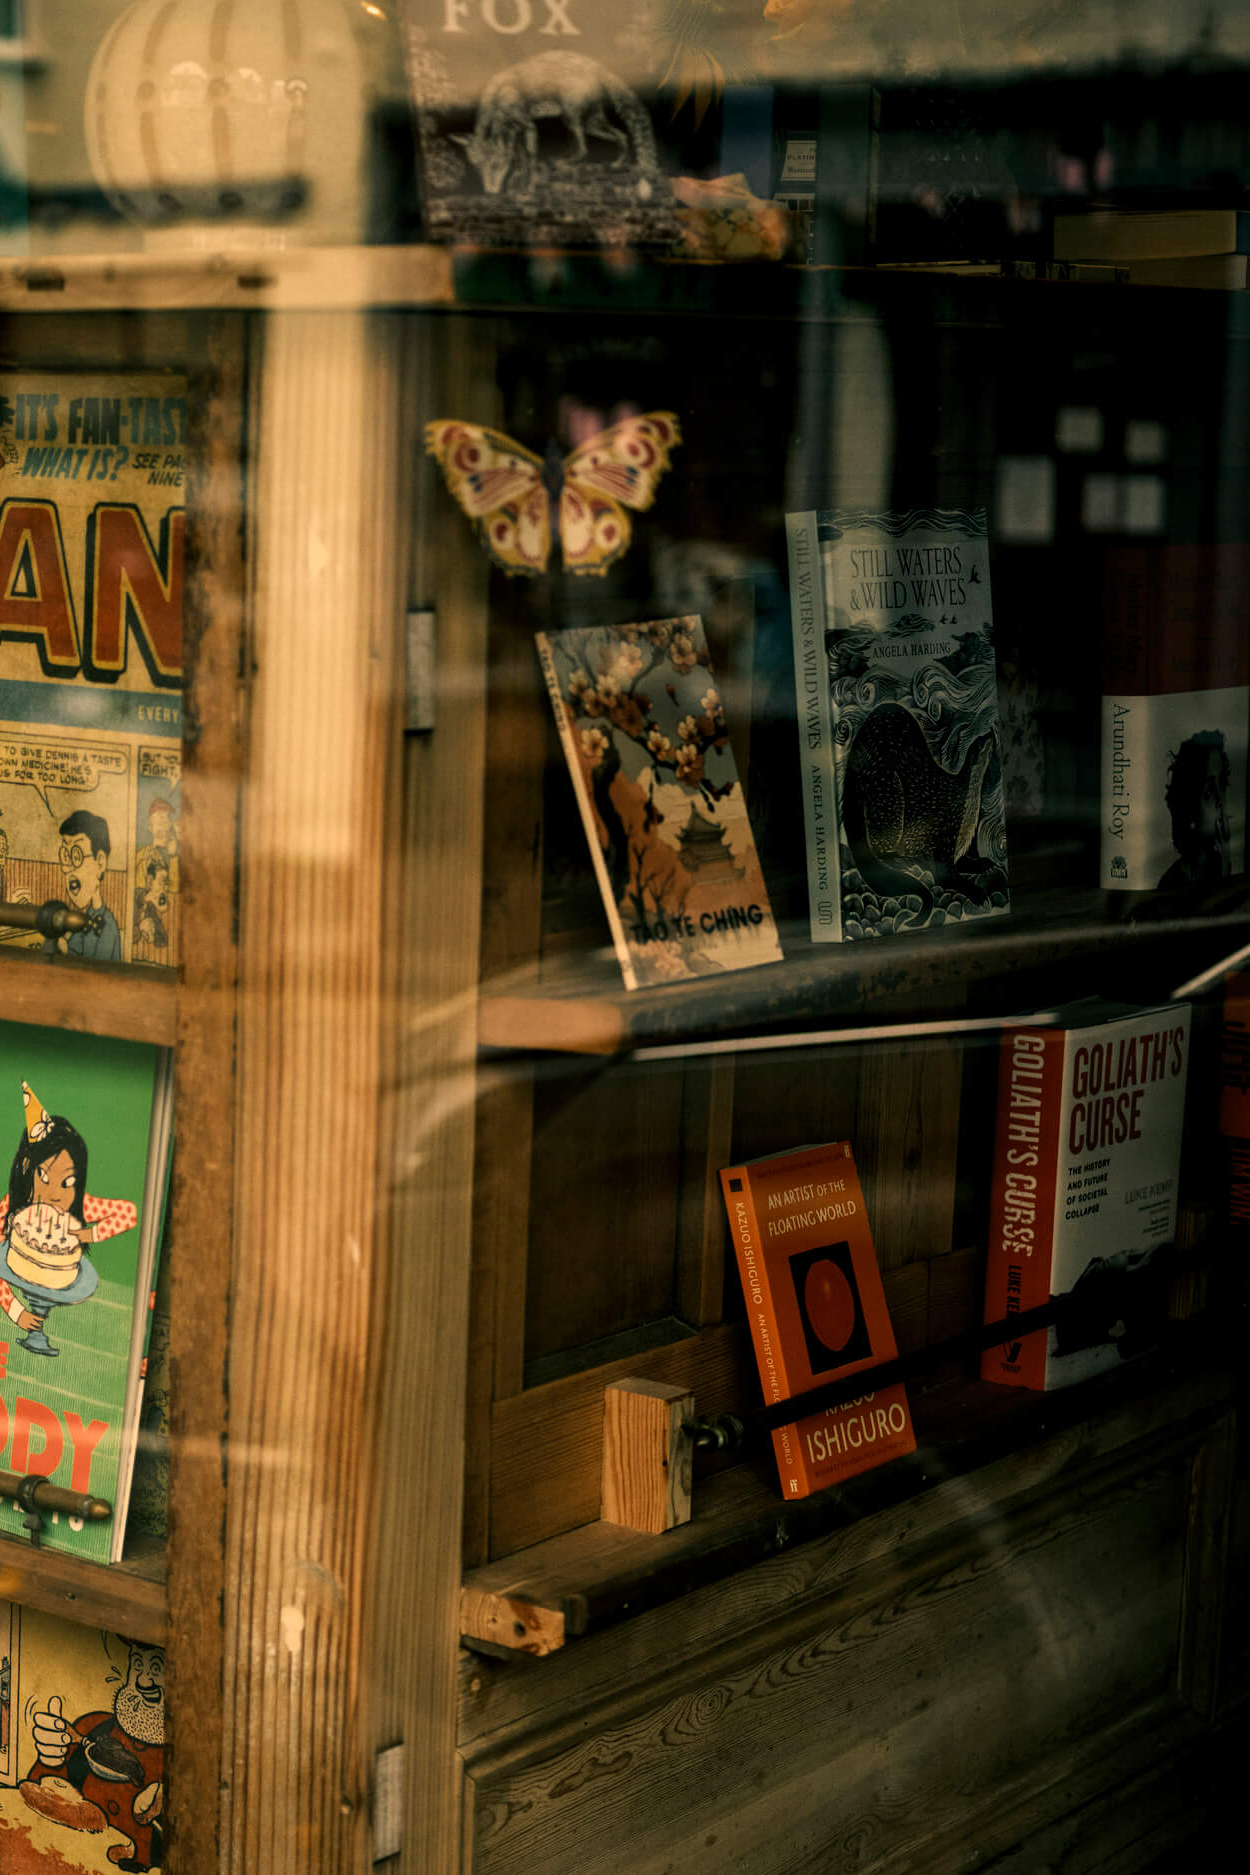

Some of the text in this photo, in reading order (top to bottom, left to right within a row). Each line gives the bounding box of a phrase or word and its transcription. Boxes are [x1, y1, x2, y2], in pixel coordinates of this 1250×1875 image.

[441, 0, 582, 36] FOX
[13, 393, 58, 442] IT'S
[21, 444, 129, 482] WHAT IS?
[132, 453, 157, 470] SEE
[147, 471, 183, 488] NINE
[850, 546, 962, 578] STILL WATERS
[861, 580, 908, 609] WILD
[910, 578, 967, 607] WAVES
[872, 641, 951, 659] ANGELA HARDING
[138, 704, 180, 724] EVERY
[796, 527, 829, 891] STILL WATERS & WILD WAVES ANGELA HARDING
[5, 745, 17, 755] TO
[20, 746, 42, 758] GIVE
[46, 749, 79, 762] DENNIS
[92, 754, 122, 767] TASTE
[1108, 703, 1131, 840] Arundhati Roy
[14, 769, 33, 780] FOR
[38, 771, 56, 782] TOO
[631, 903, 763, 943] TAO TE CHING
[1072, 1026, 1184, 1100] GOLIATH'S
[1068, 1089, 1145, 1155] CURSE
[1002, 1034, 1046, 1313] GOLIATH'S CURSE LUKE KE
[1067, 1173, 1109, 1191] AND FUTURE
[1068, 1158, 1111, 1176] THE HISTORY
[768, 1179, 847, 1210] AN ARTIST OF THE
[1066, 1188, 1109, 1206] OF SOCIETAL
[1125, 1178, 1175, 1204] LUKE KEMP
[735, 1202, 751, 1244] KAZUO
[768, 1200, 857, 1238] FLOATING WORLD
[1065, 1203, 1100, 1220] COLLAPSE
[743, 1246, 763, 1306] ISHIGURO
[757, 1313, 767, 1327] AN
[760, 1328, 772, 1357] ARTIST
[766, 1357, 775, 1370] OF
[768, 1370, 779, 1388] THE
[781, 1432, 793, 1465] WORLD
[806, 1402, 906, 1464] ISHIGURO
